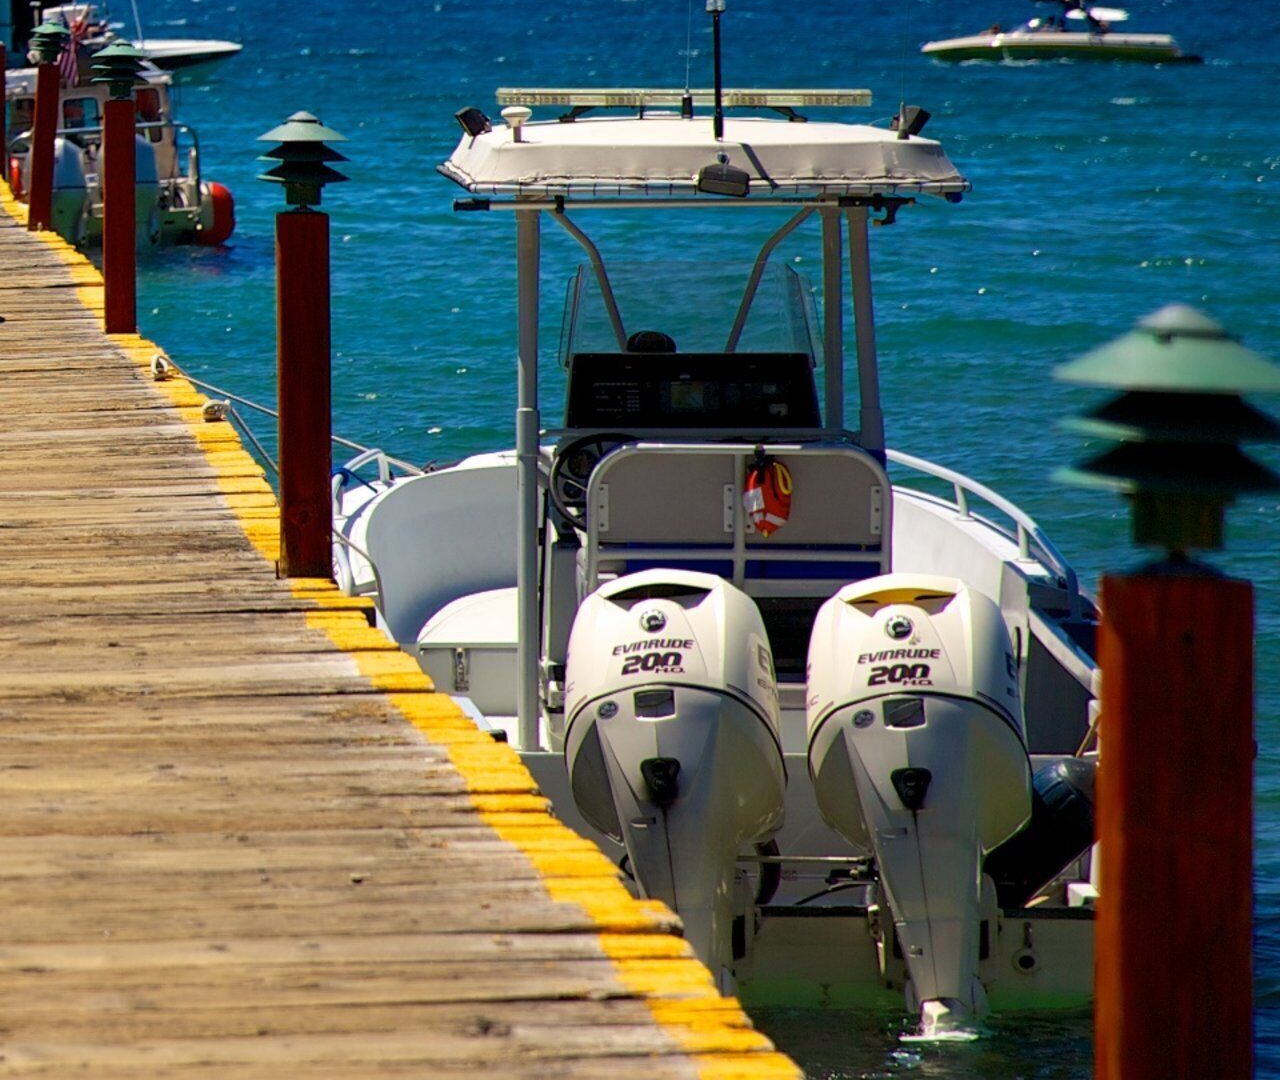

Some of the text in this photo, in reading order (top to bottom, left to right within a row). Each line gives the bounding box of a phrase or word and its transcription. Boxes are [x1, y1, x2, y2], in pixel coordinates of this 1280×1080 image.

[612, 638, 695, 656] EVINRUDE
[857, 648, 941, 664] EVINRUDE
[621, 651, 683, 676] 200
[867, 663, 931, 687] 200
